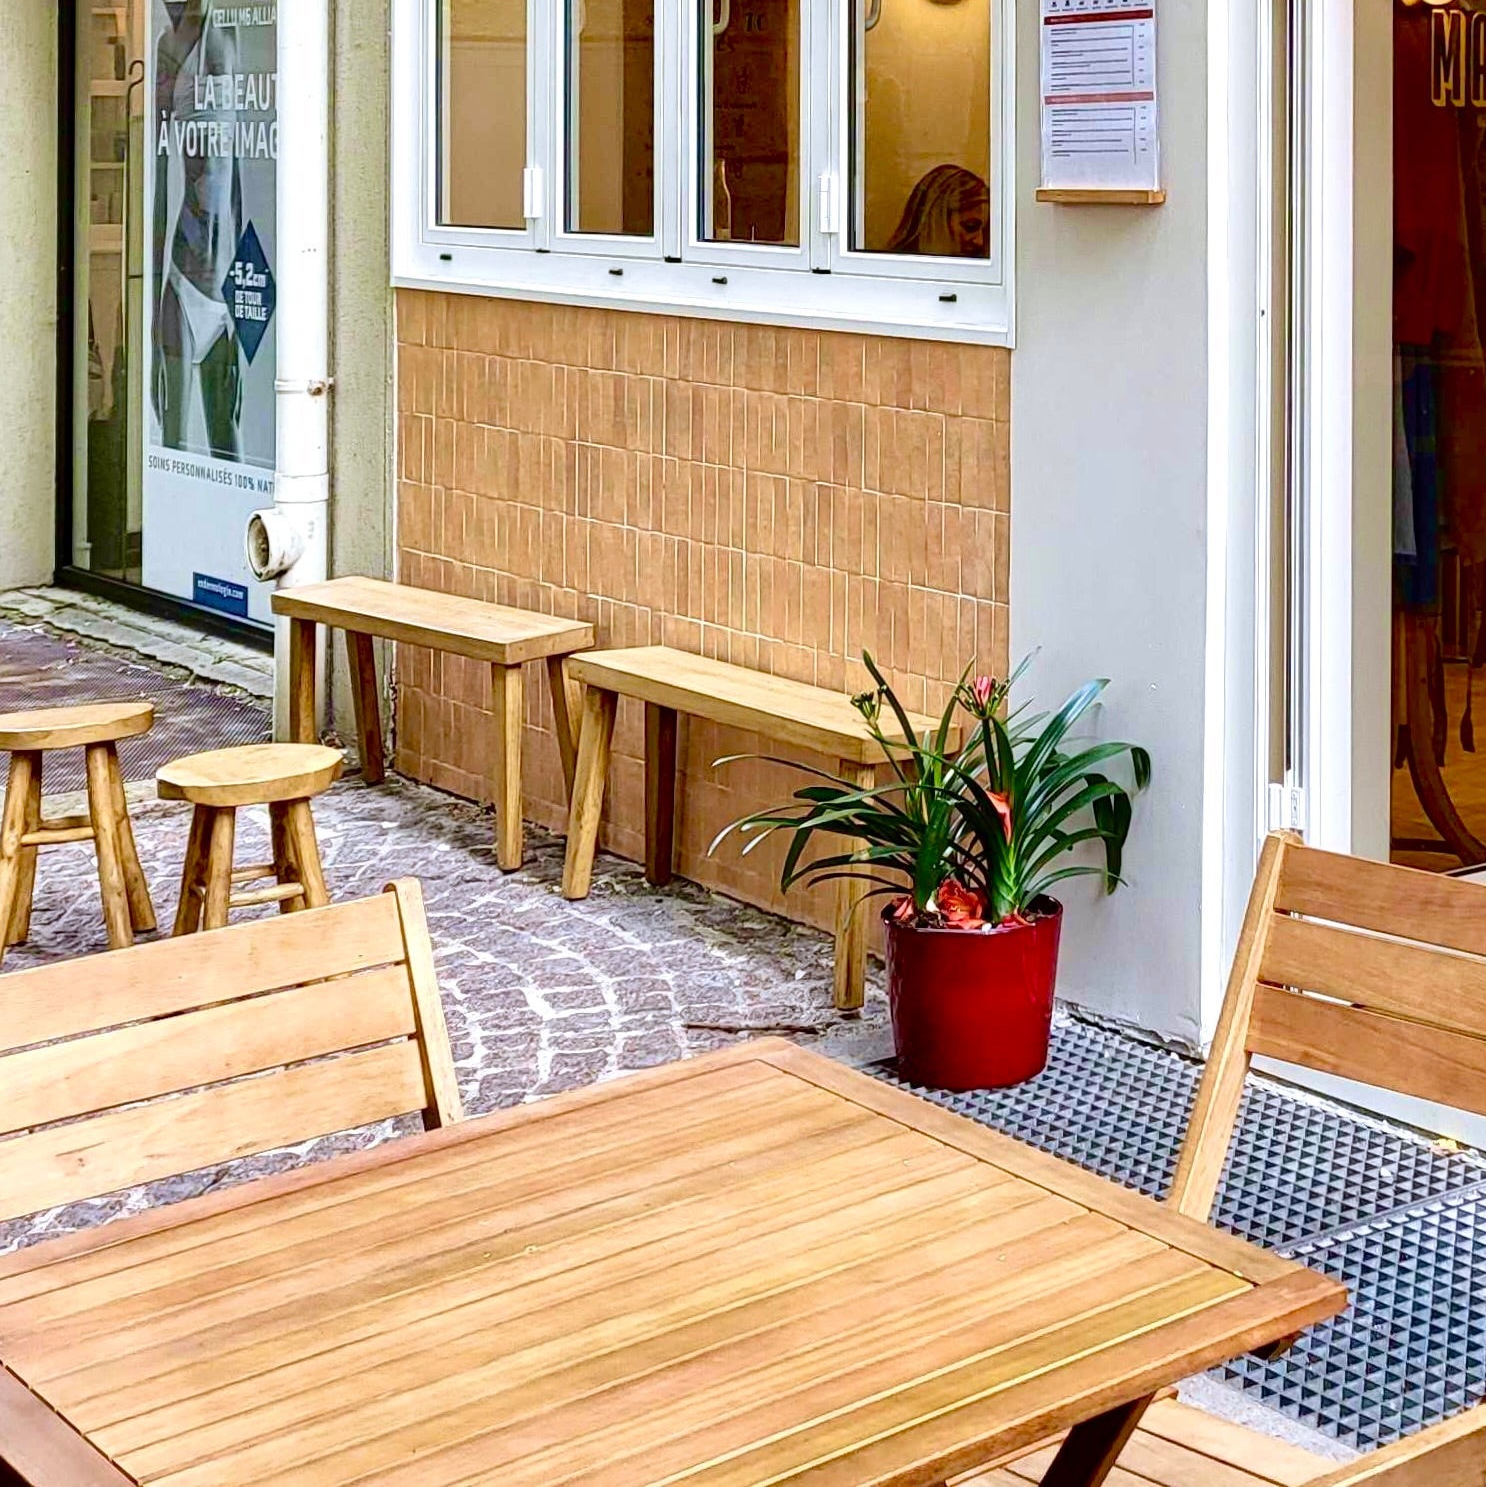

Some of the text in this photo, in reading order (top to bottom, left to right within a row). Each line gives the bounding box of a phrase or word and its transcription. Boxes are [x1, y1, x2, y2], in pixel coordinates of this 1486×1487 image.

[194, 74, 216, 110] LA
[157, 109, 170, 156] À
[174, 120, 231, 158] VOTRE
[148, 455, 170, 472] SOINS
[172, 459, 233, 486] PERSONNALISÉS
[234, 473, 255, 491] 100%
